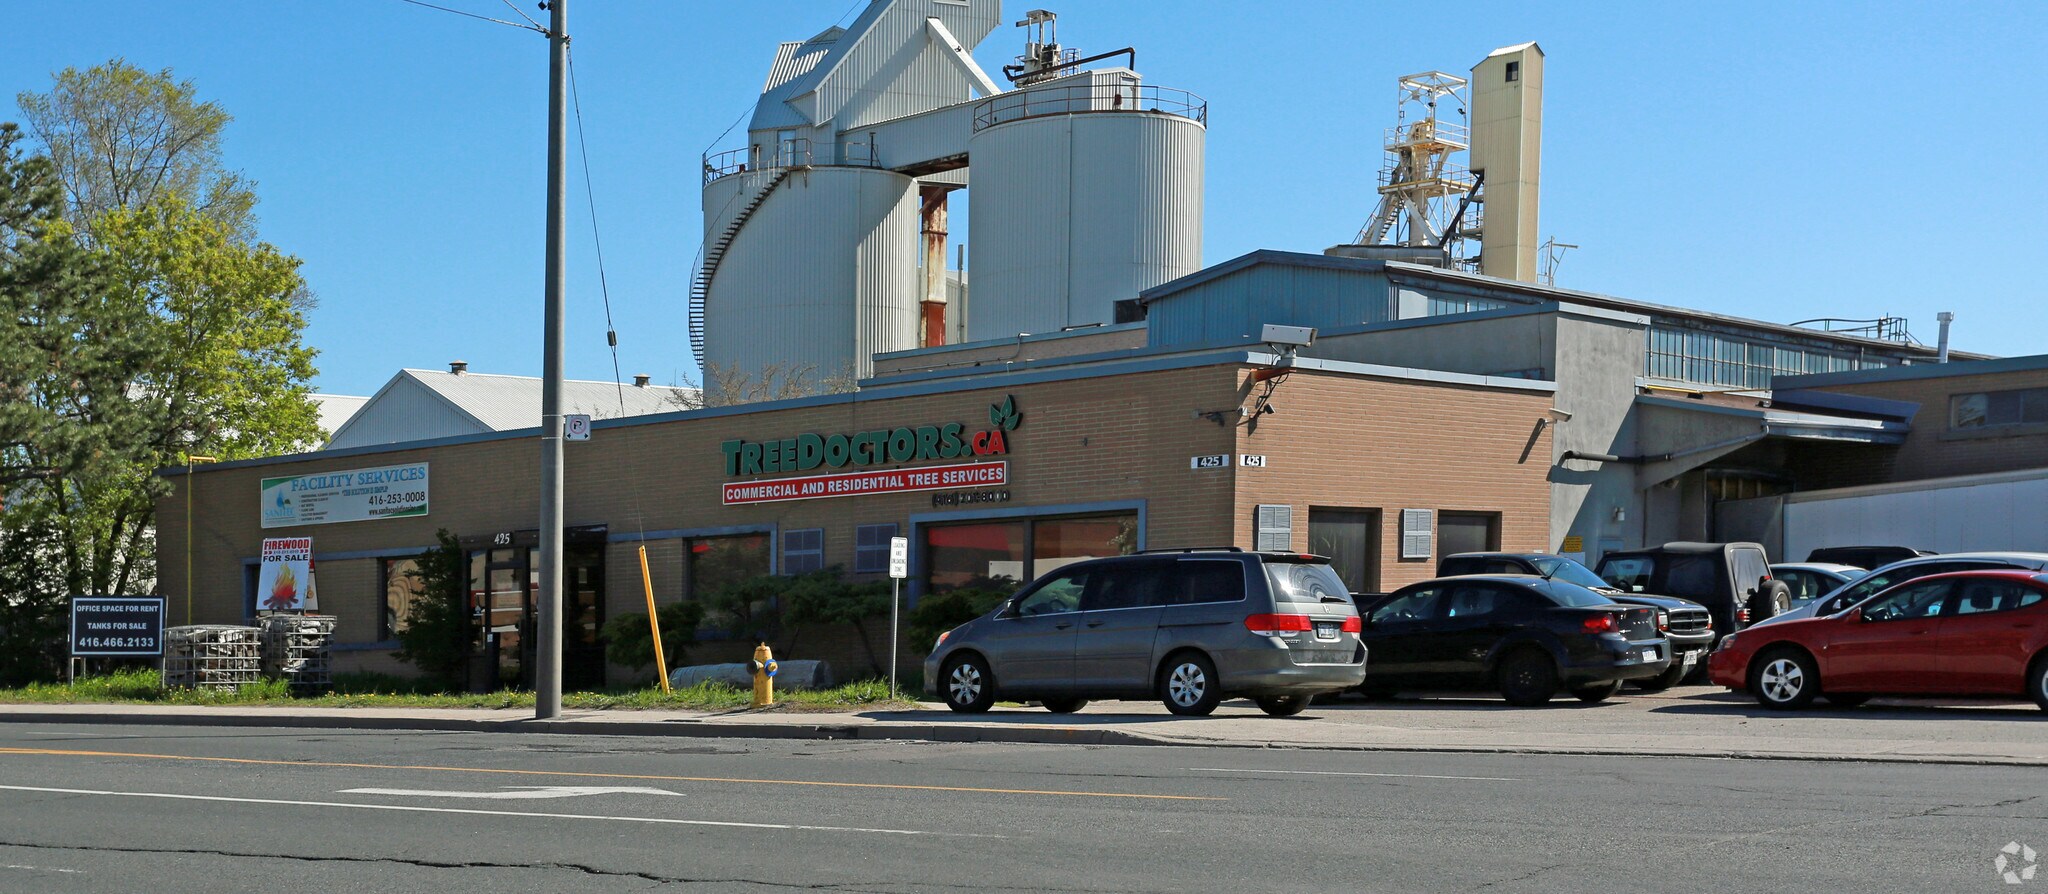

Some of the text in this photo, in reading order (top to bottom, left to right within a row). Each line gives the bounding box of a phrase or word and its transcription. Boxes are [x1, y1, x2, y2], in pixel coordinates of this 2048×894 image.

[1200, 456, 1220, 467] 425
[1245, 455, 1260, 466] 425
[291, 466, 426, 492] FACILITY SERVICES
[726, 467, 1004, 501] COMMERCIAL AND RESIDENTIAL TREE SERVICES
[368, 491, 426, 506] 416-253-0008
[263, 538, 310, 550] FIREWOOD
[494, 533, 510, 545] 425
[263, 553, 309, 563] FOR SALE
[87, 622, 147, 630] TANKS FOR SALE
[79, 637, 154, 647] 416.466.2133
